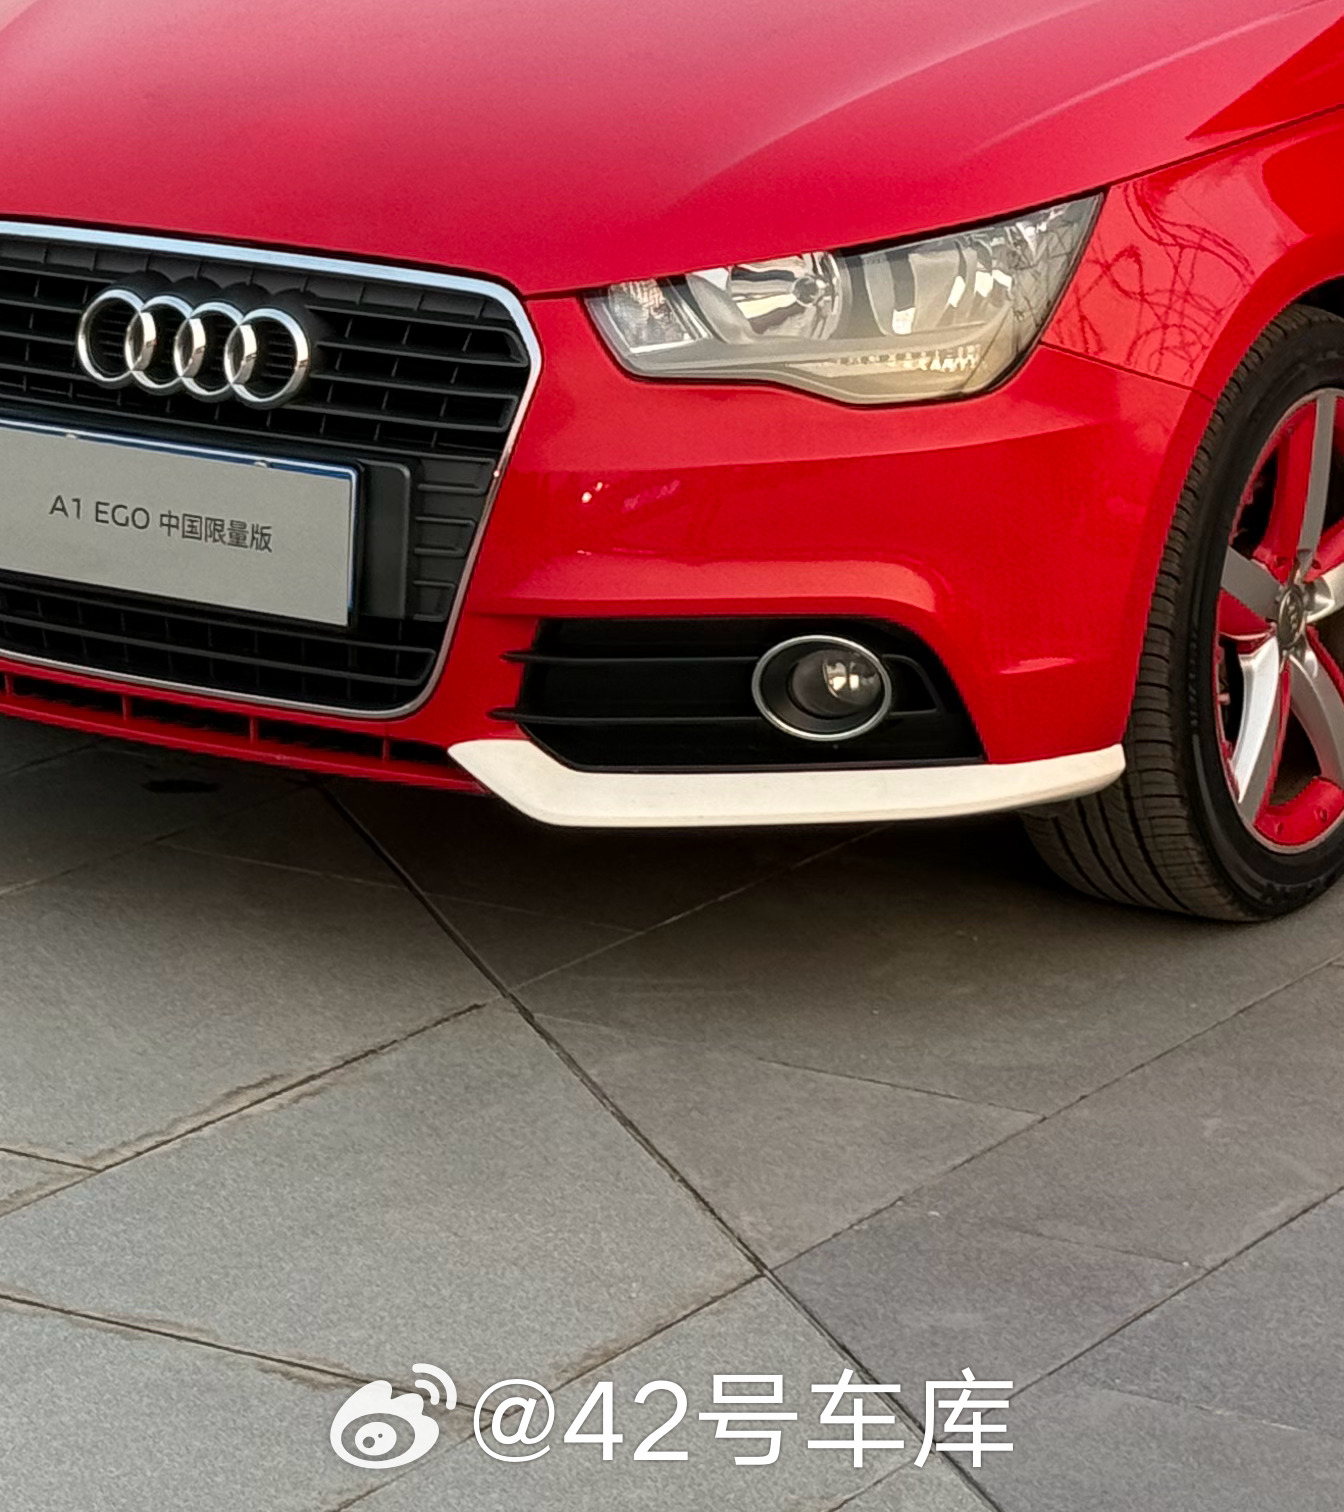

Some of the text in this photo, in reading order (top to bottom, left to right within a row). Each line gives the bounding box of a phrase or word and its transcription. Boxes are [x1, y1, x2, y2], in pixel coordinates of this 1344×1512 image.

[49, 494, 273, 553] A1 EGO 中国限量版
